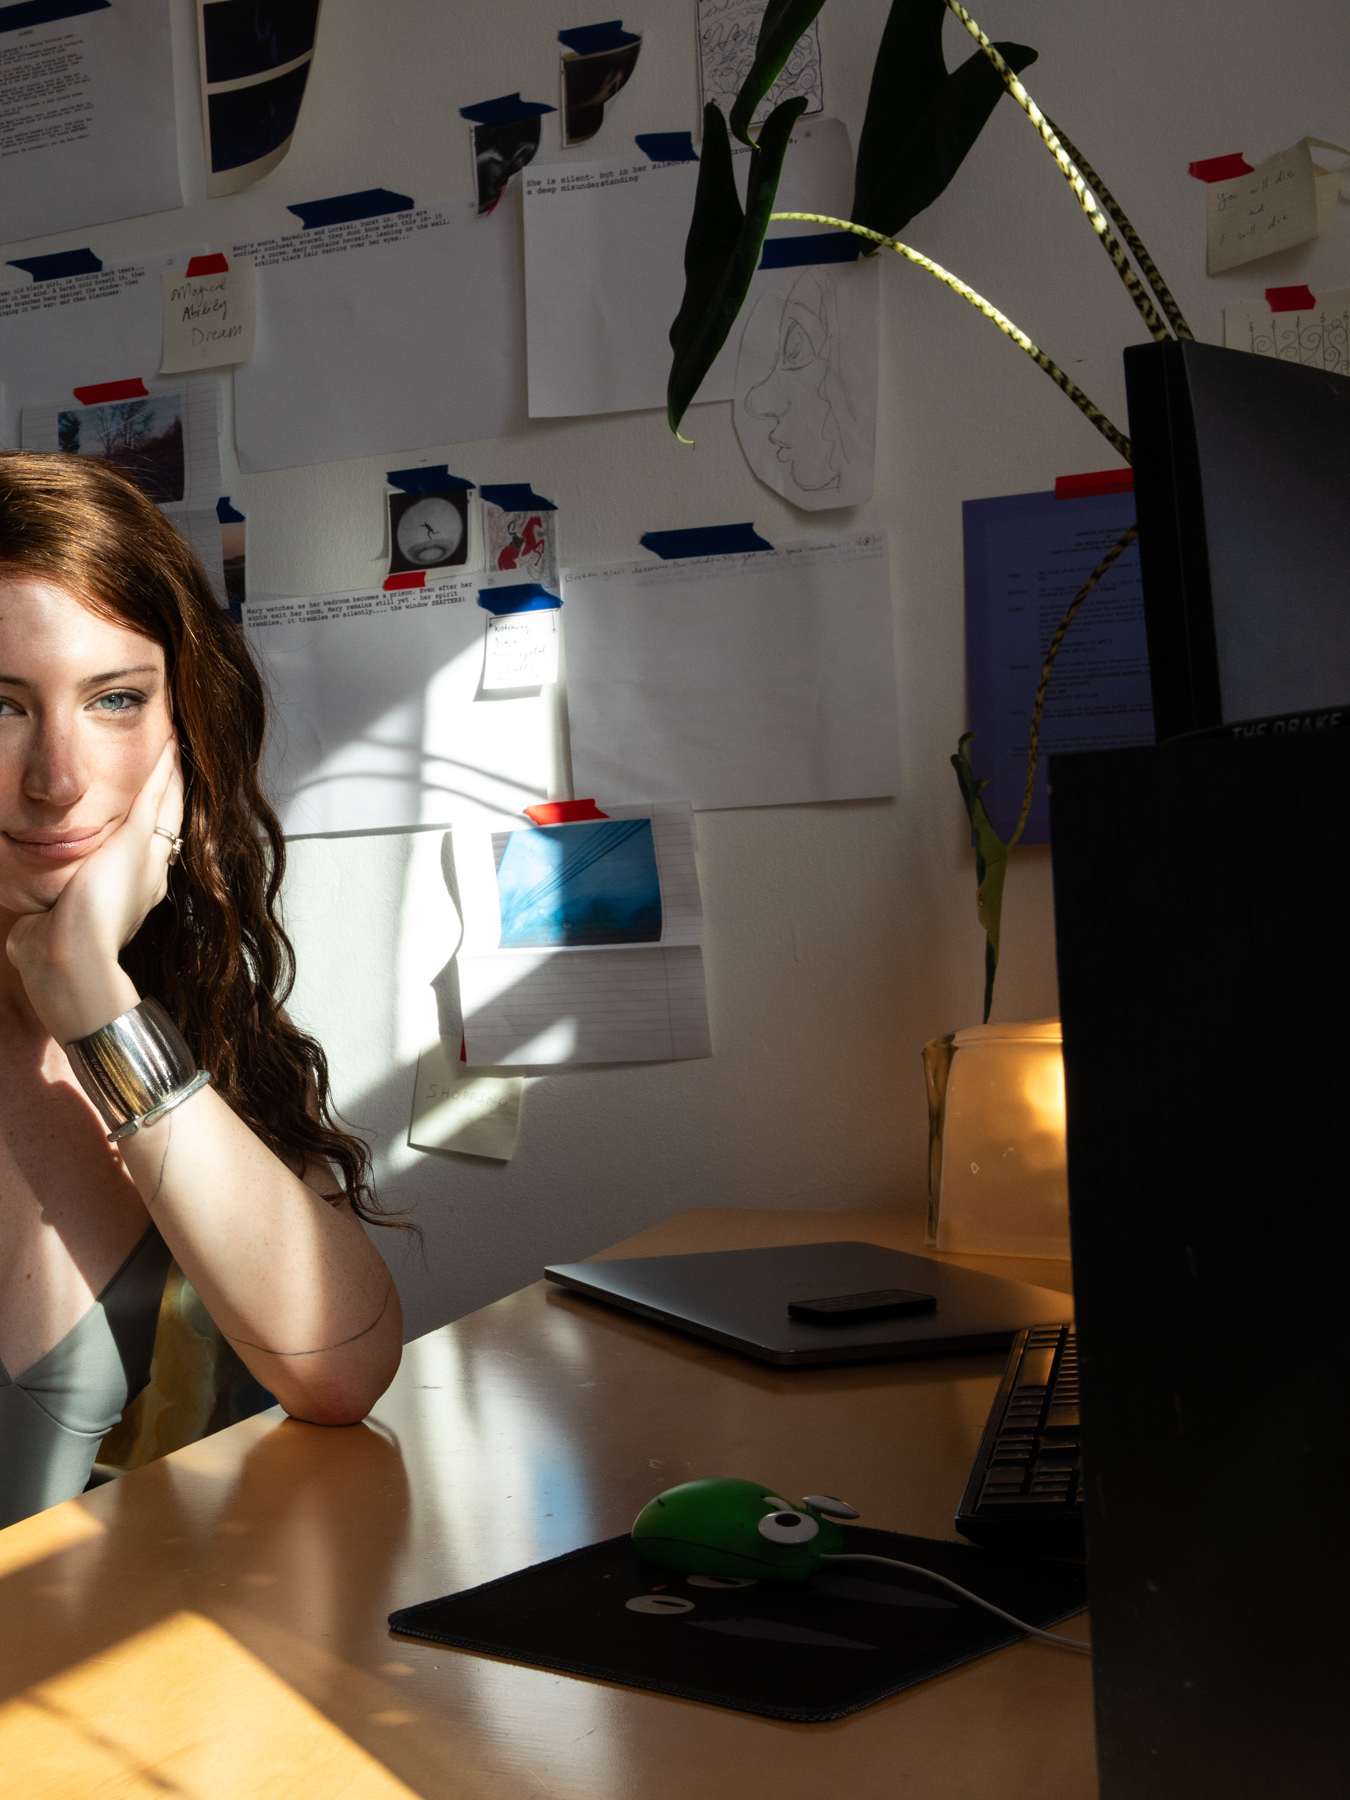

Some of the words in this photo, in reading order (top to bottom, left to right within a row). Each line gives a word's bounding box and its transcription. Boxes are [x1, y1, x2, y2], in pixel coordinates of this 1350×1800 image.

[537, 187, 556, 195] deep
[561, 176, 638, 192] misunderstanding
[1250, 179, 1268, 194] will
[1276, 170, 1294, 184] die
[1249, 205, 1264, 215] and
[1239, 226, 1255, 239] will
[1268, 214, 1288, 231] die
[233, 243, 254, 251] Mary's
[282, 232, 311, 242] Meredith
[361, 219, 380, 227] burst
[311, 241, 340, 250] contains
[377, 229, 402, 237] leaning
[322, 246, 347, 254] dancing
[60, 284, 76, 292] harsh
[96, 277, 115, 285] breath
[76, 274, 99, 282] holding
[15, 299, 41, 307] branches
[60, 289, 83, 299] against
[191, 325, 241, 346] Dream
[565, 572, 597, 582] Broken
[267, 605, 293, 613] watches
[324, 598, 350, 606] bedroom
[398, 597, 410, 605] yet
[436, 591, 457, 600] spirit
[1232, 723, 1267, 738] THE
[426, 1084, 508, 1106] SHOPPING
